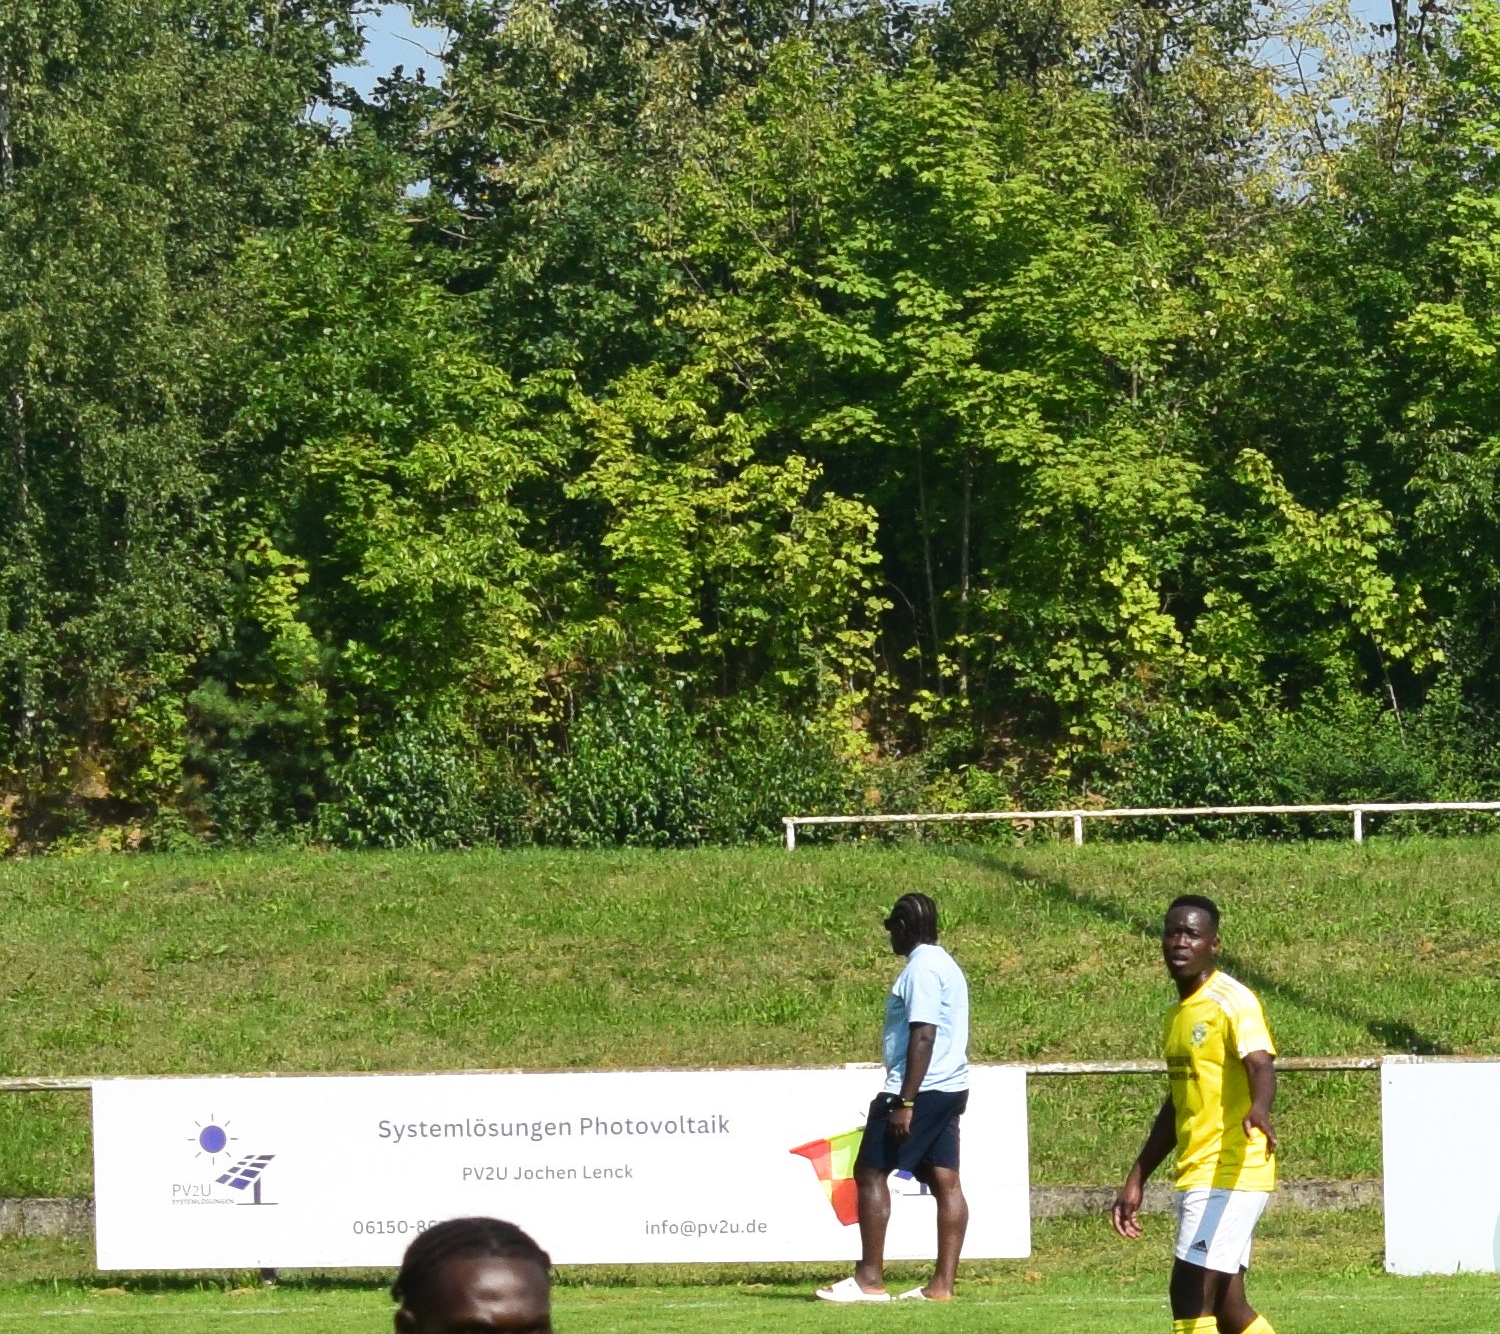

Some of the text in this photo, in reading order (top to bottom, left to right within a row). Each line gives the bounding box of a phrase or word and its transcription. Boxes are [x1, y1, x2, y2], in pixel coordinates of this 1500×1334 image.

[378, 1114, 730, 1144] Systemlösungen Photovoltaik
[462, 1164, 633, 1181] PV2U Jochen Lenck
[172, 1183, 211, 1197] PV2U
[645, 1218, 768, 1238] info@pv2u.de
